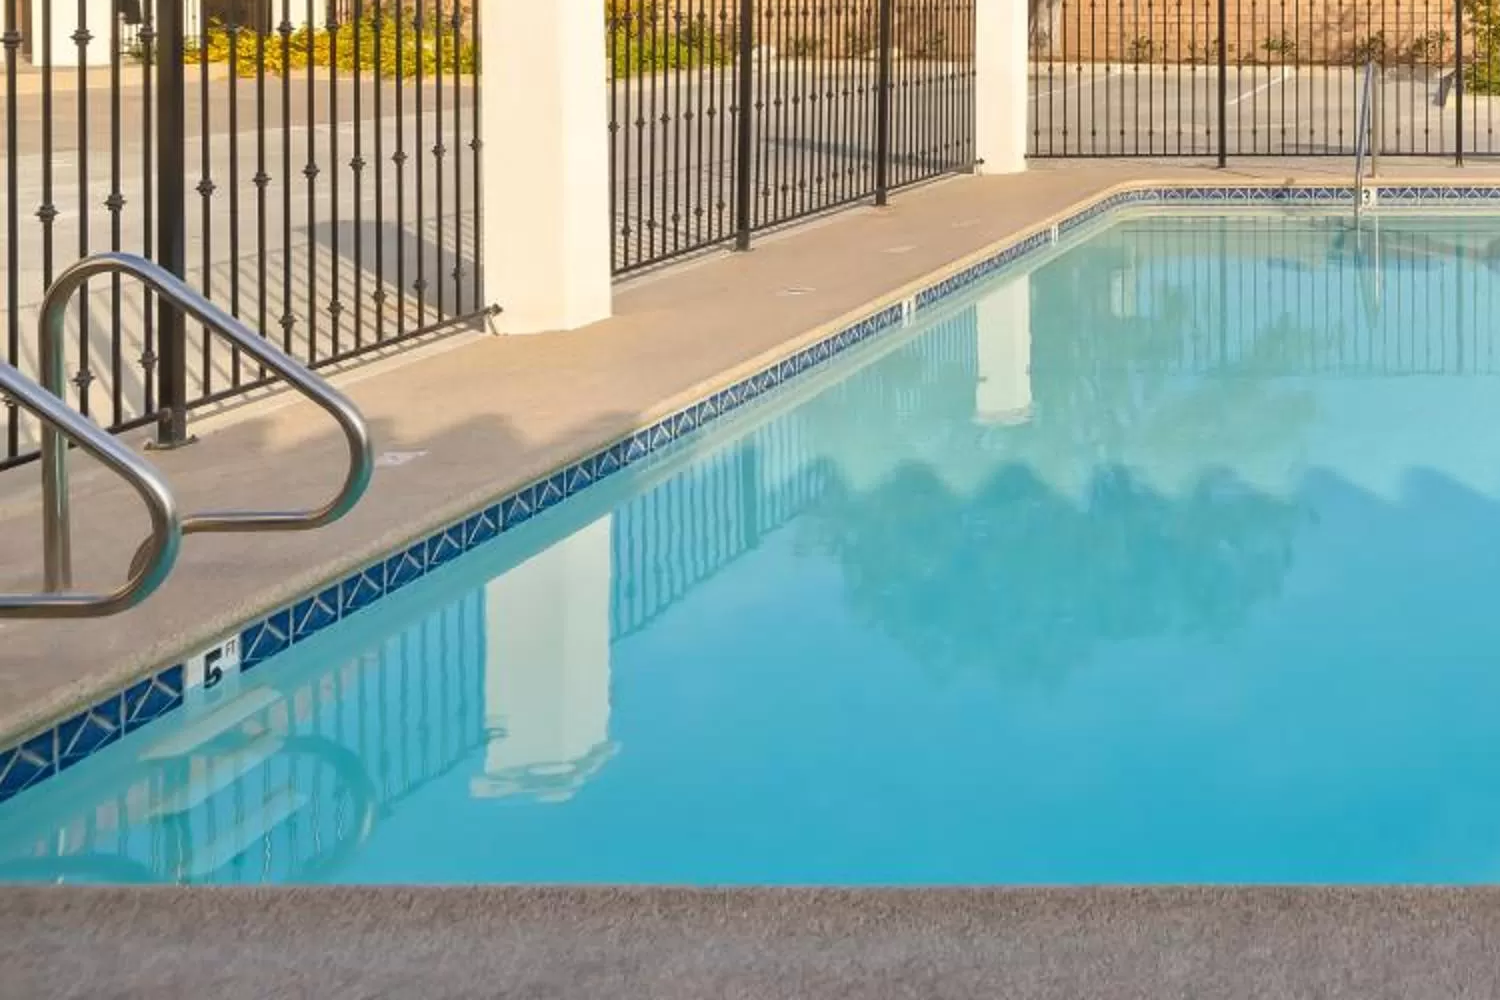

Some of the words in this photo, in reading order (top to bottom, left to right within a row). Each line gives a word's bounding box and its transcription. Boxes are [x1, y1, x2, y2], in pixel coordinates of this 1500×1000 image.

[1363, 188, 1371, 205] 3
[204, 647, 223, 689] 5
[225, 640, 236, 658] FT
